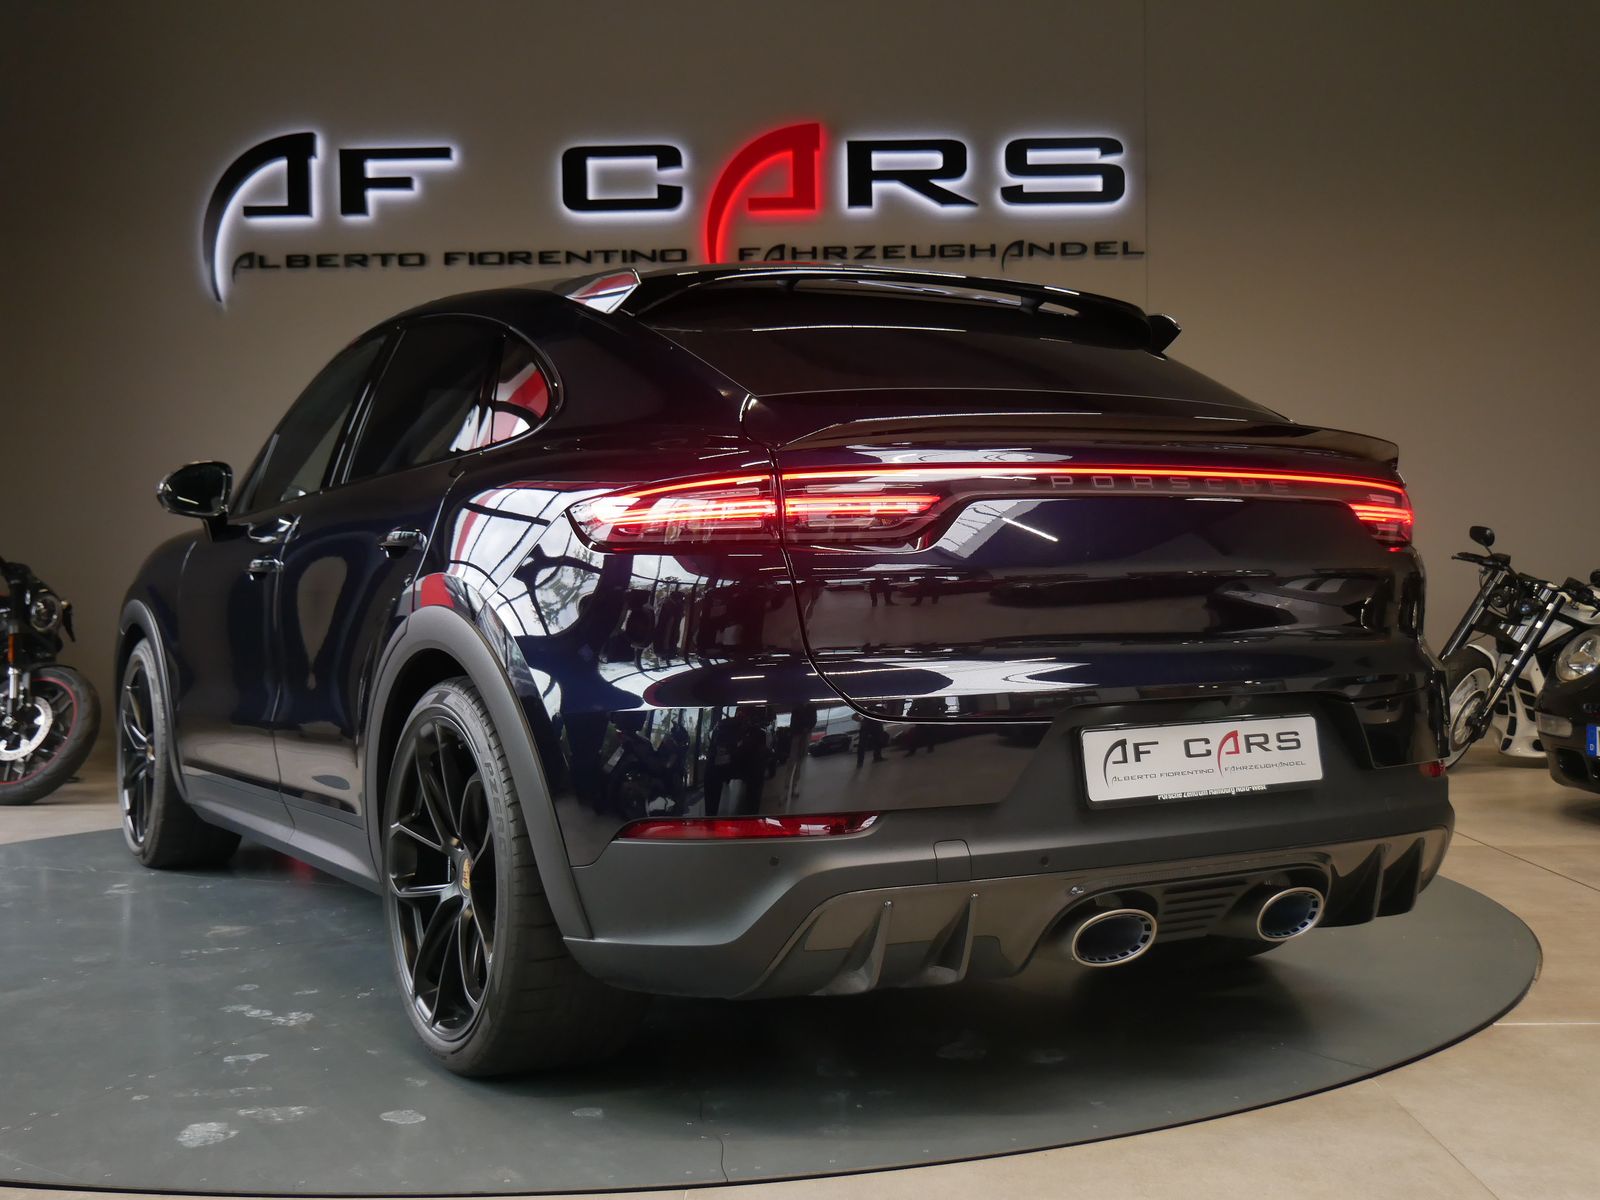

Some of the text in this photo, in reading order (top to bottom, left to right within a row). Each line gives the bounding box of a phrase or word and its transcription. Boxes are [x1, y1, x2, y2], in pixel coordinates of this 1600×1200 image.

[203, 123, 1125, 302] AF CARS
[232, 240, 1145, 283] ALBERTO FIORENTINO FAHRZEUGHANDEL
[1050, 475, 1288, 493] PORSCHE
[1103, 730, 1302, 789] AF CARS
[1112, 760, 1306, 785] ALBERTO FIORENTINO FAHRZEUGHANDEL
